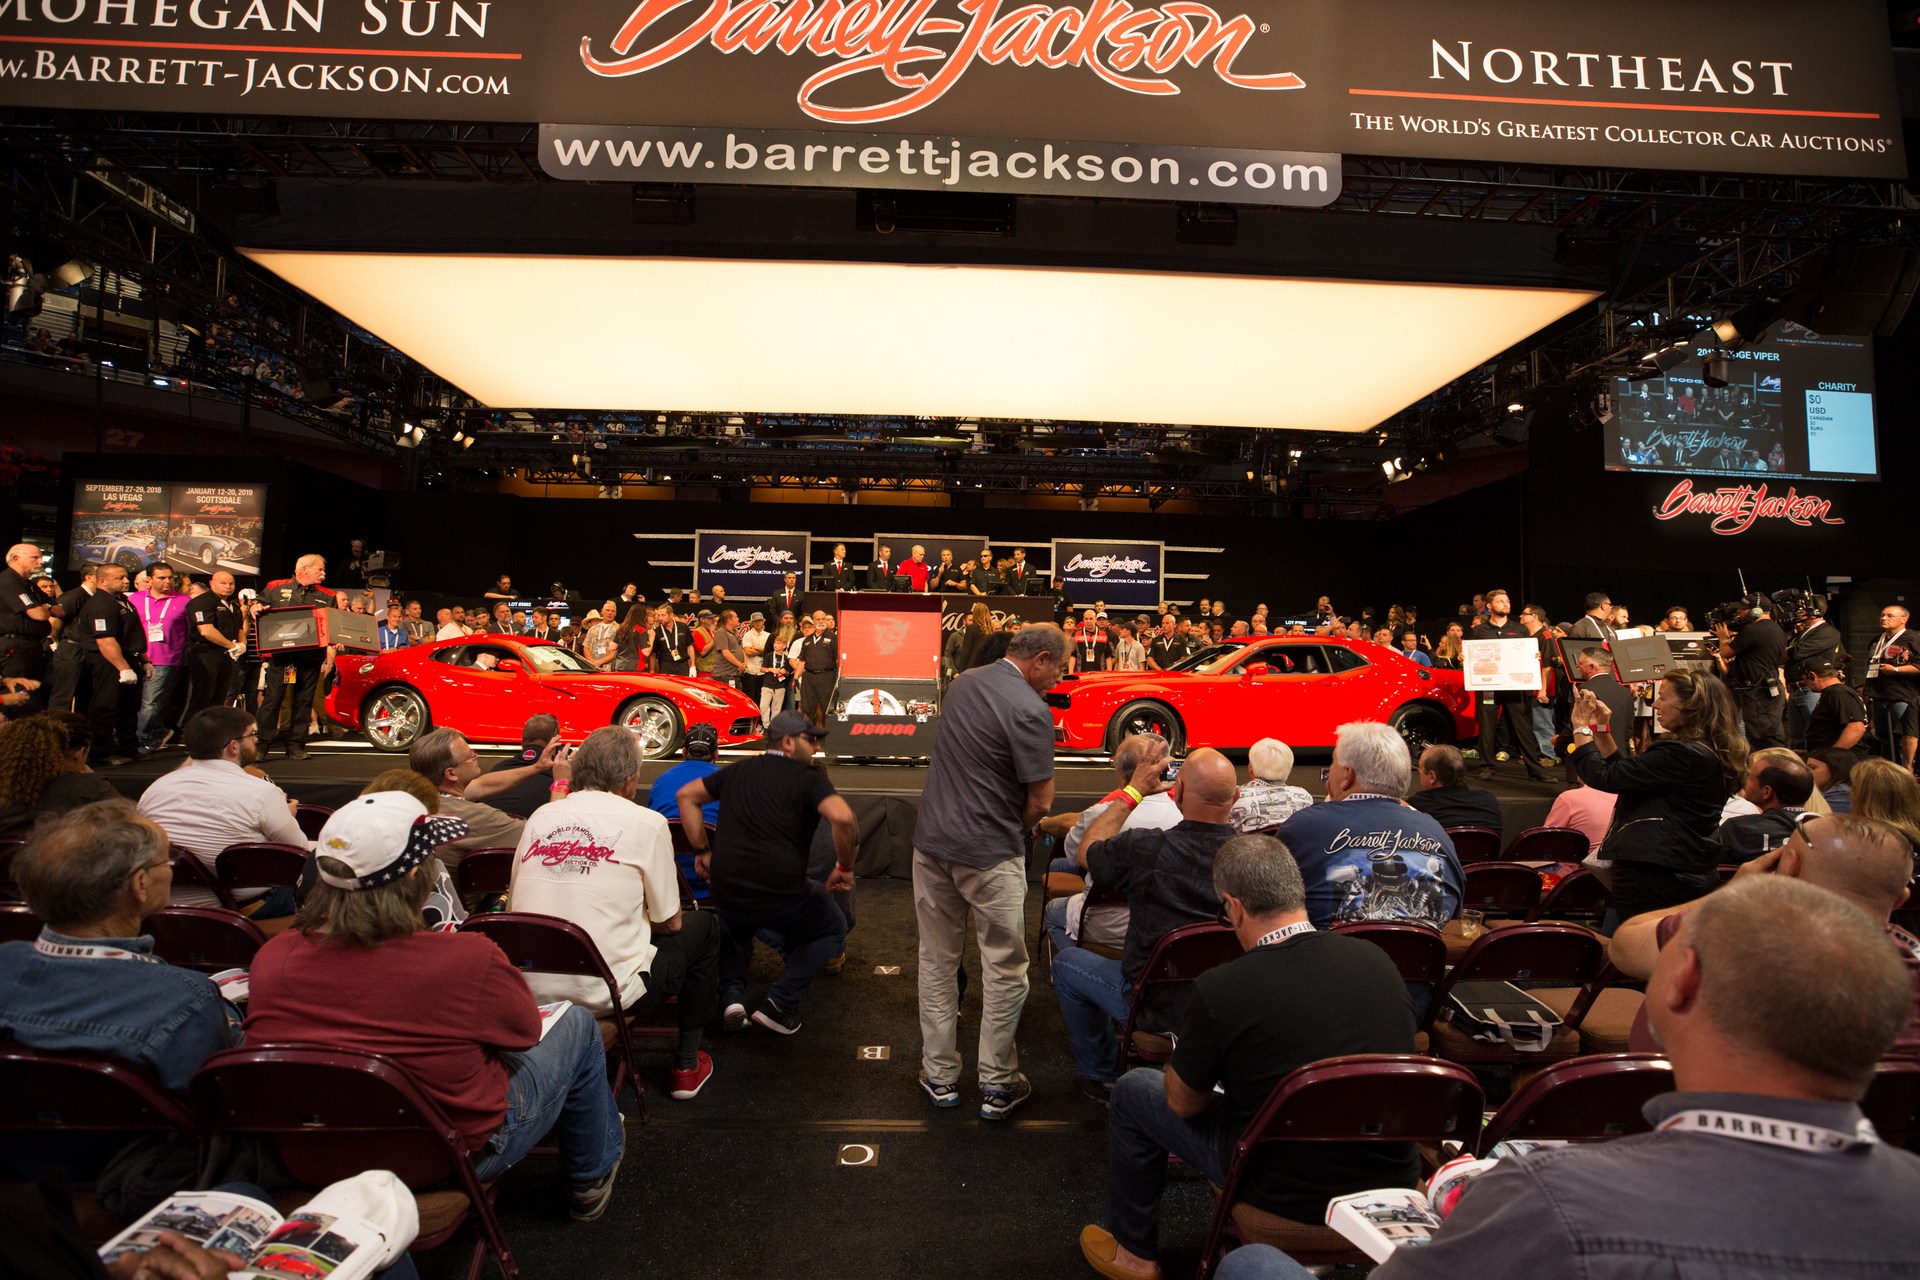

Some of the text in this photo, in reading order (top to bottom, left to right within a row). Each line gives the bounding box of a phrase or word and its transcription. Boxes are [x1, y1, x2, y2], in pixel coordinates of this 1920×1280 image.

[0, 0, 491, 38] OHEGAN SUN
[1429, 39, 1792, 96] NORTHEAST
[1350, 112, 1394, 131] THE
[1399, 115, 1490, 136] WORLD'S
[1497, 120, 1598, 141] GREATEST
[1604, 125, 1727, 146] COLLECTOR
[1730, 131, 1774, 148] CAR
[553, 132, 1328, 193] www.barrett-jackson.com
[1753, 351, 1780, 361] VIPER
[1669, 377, 1705, 385] DODG
[1818, 382, 1856, 391] CHARITY
[1809, 394, 1821, 404] $0
[105, 428, 145, 448] 27
[119, 493, 143, 501] VEGAS
[196, 496, 242, 504] SCOTTSDALE
[1652, 479, 1846, 535] Barrett-Jackson
[546, 826, 595, 841] WORLD FAMOUS
[1324, 828, 1447, 860] Barrett-Jackson
[879, 966, 899, 974] A
[863, 1046, 886, 1060] B
[841, 1144, 874, 1165] C
